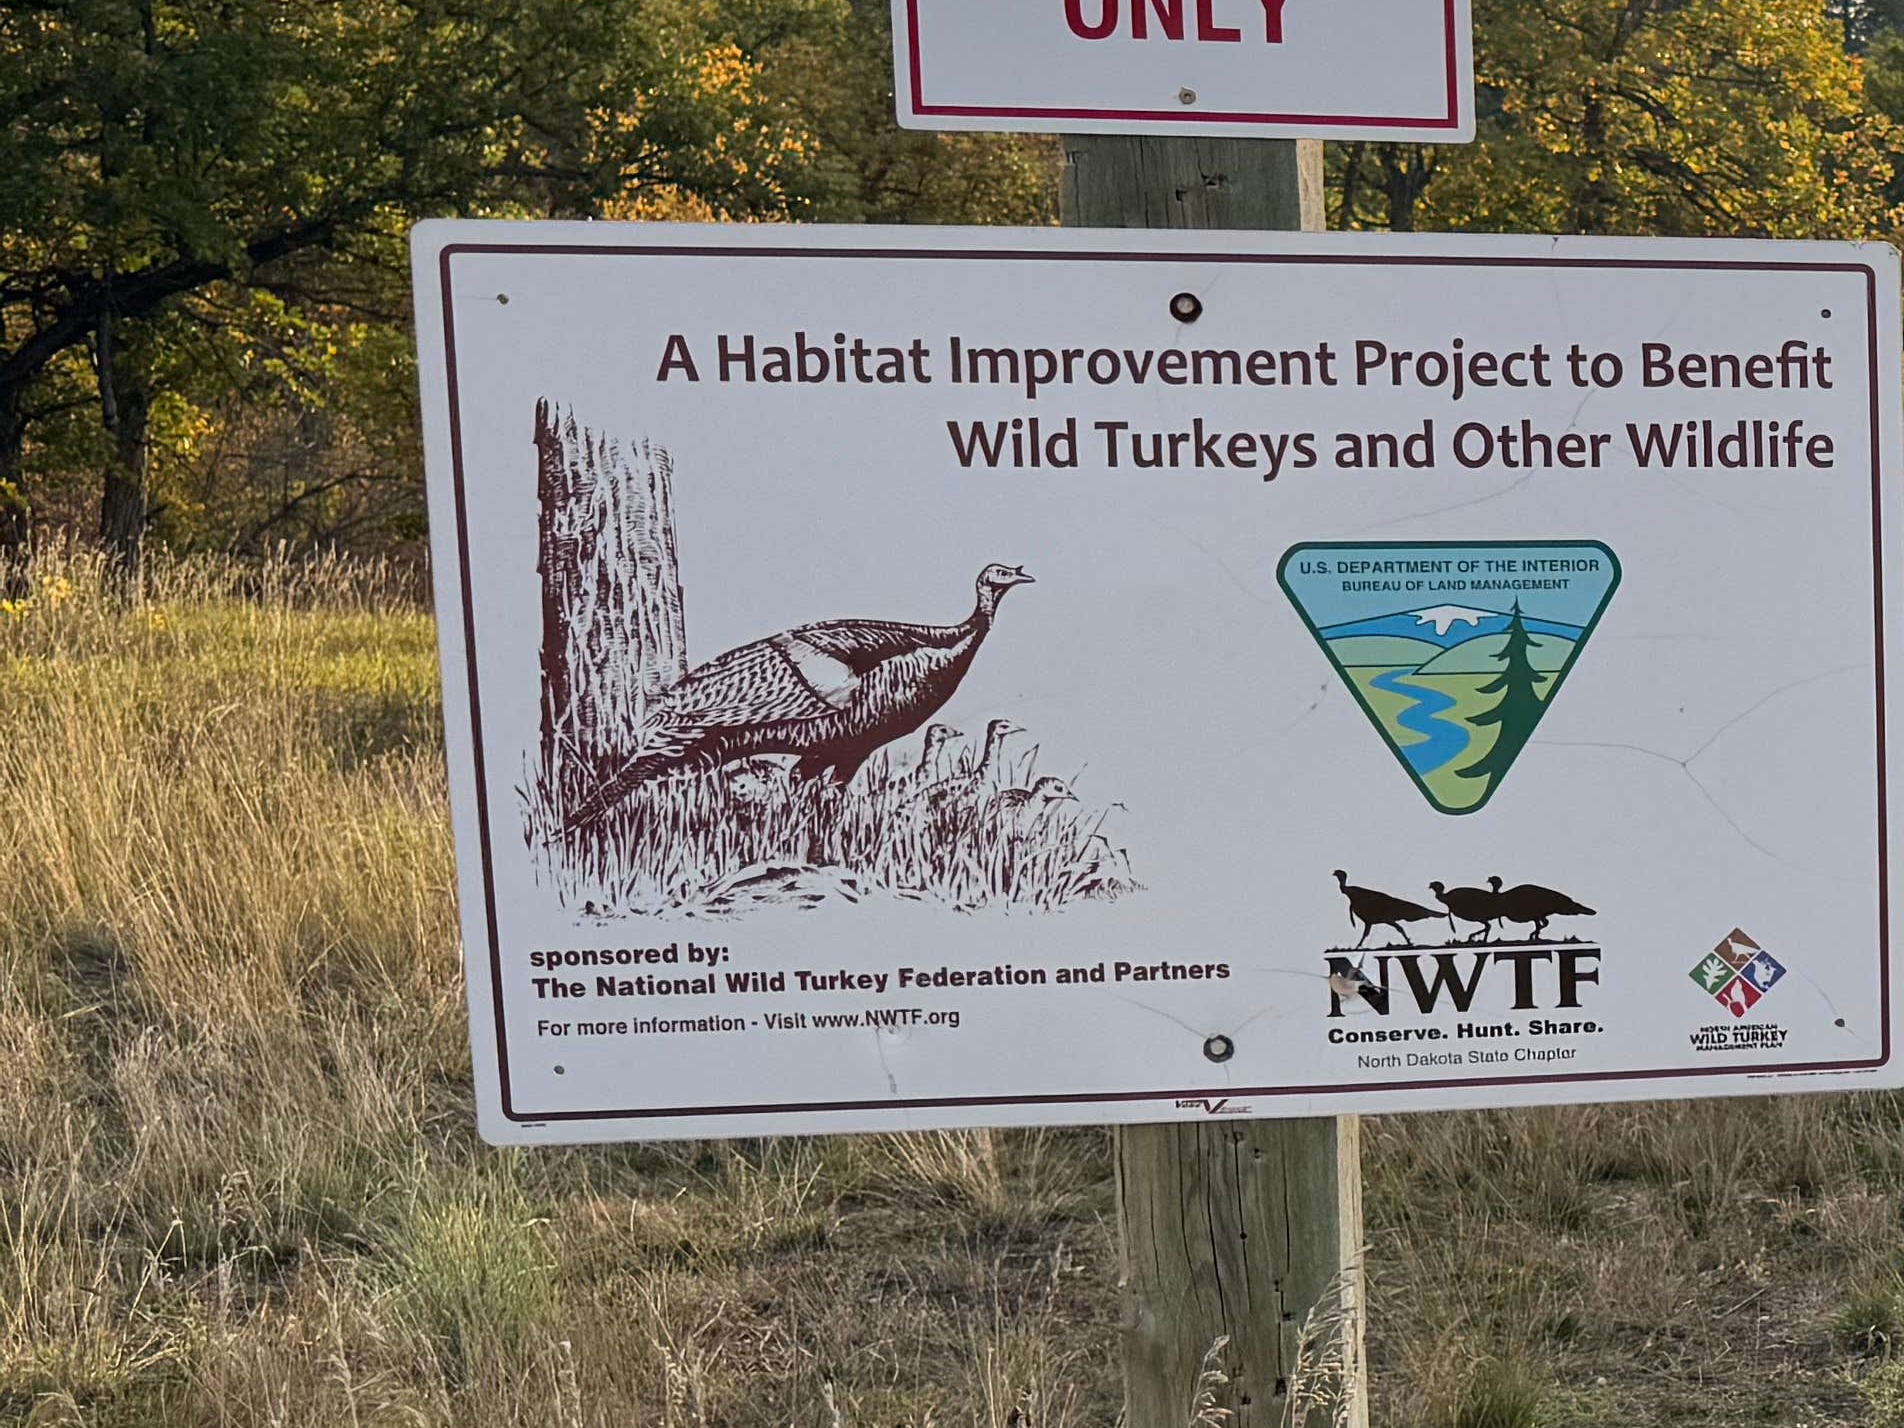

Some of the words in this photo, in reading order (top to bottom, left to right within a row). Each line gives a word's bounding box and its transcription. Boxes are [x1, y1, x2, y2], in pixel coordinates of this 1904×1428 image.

[657, 335, 699, 381] A
[717, 332, 931, 383] Habitat
[950, 337, 1337, 399] Improvement
[1355, 338, 1551, 400] Project
[1567, 344, 1623, 388] to
[1641, 340, 1832, 389] Benefit
[947, 418, 1077, 468] Wild
[1095, 418, 1317, 482] Turkeys
[1336, 419, 1434, 468] and
[1453, 419, 1611, 468] Other
[1626, 420, 1834, 468] Wildlife
[1299, 561, 1332, 575] U.S.
[1337, 560, 1453, 574] DEPARTMENT
[1457, 560, 1480, 573] OF
[1485, 559, 1517, 573] THE
[1522, 559, 1600, 573] INTERIOR
[1342, 580, 1401, 592] BUREAU
[1405, 580, 1424, 591] OF
[1428, 579, 1467, 591] LAND
[1470, 578, 1570, 590] MANAGEMENT
[530, 943, 678, 971] sponsored
[688, 943, 729, 967] by:
[532, 977, 586, 998] The
[596, 974, 715, 997] National
[725, 971, 786, 993] Wild
[794, 969, 889, 993] Turkey
[898, 964, 1046, 988] Federation
[1056, 962, 1105, 984] and
[1114, 961, 1231, 982] Partners
[1323, 947, 1602, 1018] NWTF
[537, 1019, 571, 1037] For
[577, 1021, 628, 1036] more
[633, 1015, 746, 1034] information
[764, 1013, 807, 1030] Visit
[812, 1009, 960, 1028] www.NWTF.org
[1328, 1026, 1449, 1044] Conserve.
[1456, 1022, 1521, 1039] Hunt.
[1528, 1019, 1604, 1036] Share.
[1690, 1032, 1728, 1045] WILD
[1732, 1029, 1788, 1043] TURKEY
[1357, 1054, 1401, 1069] North
[1406, 1051, 1463, 1067] Dakota
[1468, 1048, 1510, 1064] State
[1514, 1046, 1577, 1064] Chapter
